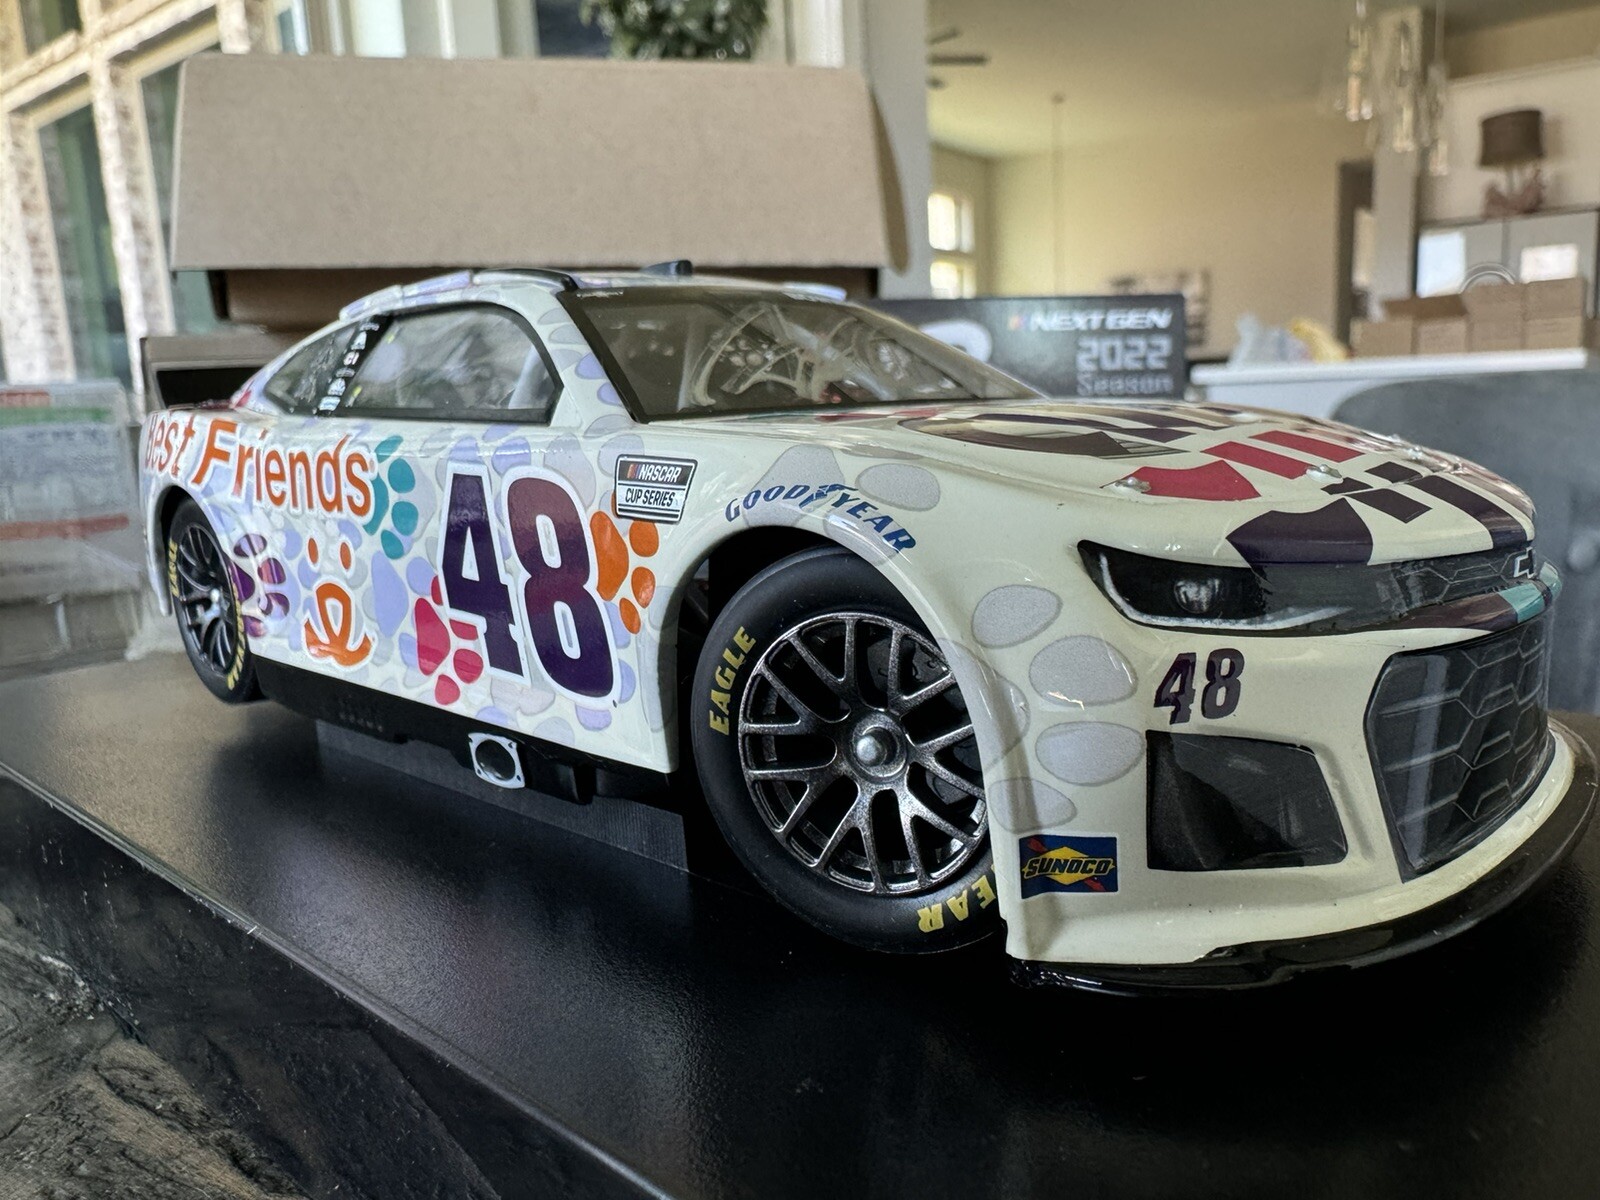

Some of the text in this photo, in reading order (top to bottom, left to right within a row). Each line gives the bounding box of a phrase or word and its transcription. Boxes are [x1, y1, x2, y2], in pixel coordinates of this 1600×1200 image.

[1030, 307, 1173, 331] NEXT GEN
[1076, 334, 1173, 371] 2022
[1077, 373, 1174, 396] Season
[191, 418, 372, 517] Friends
[638, 463, 682, 483] NASCAR
[625, 487, 676, 507] CUP SERIES
[442, 471, 615, 699] 48
[709, 625, 757, 736] EAGLE
[1153, 647, 1245, 725] 48
[1024, 857, 1112, 879] SUNOCO
